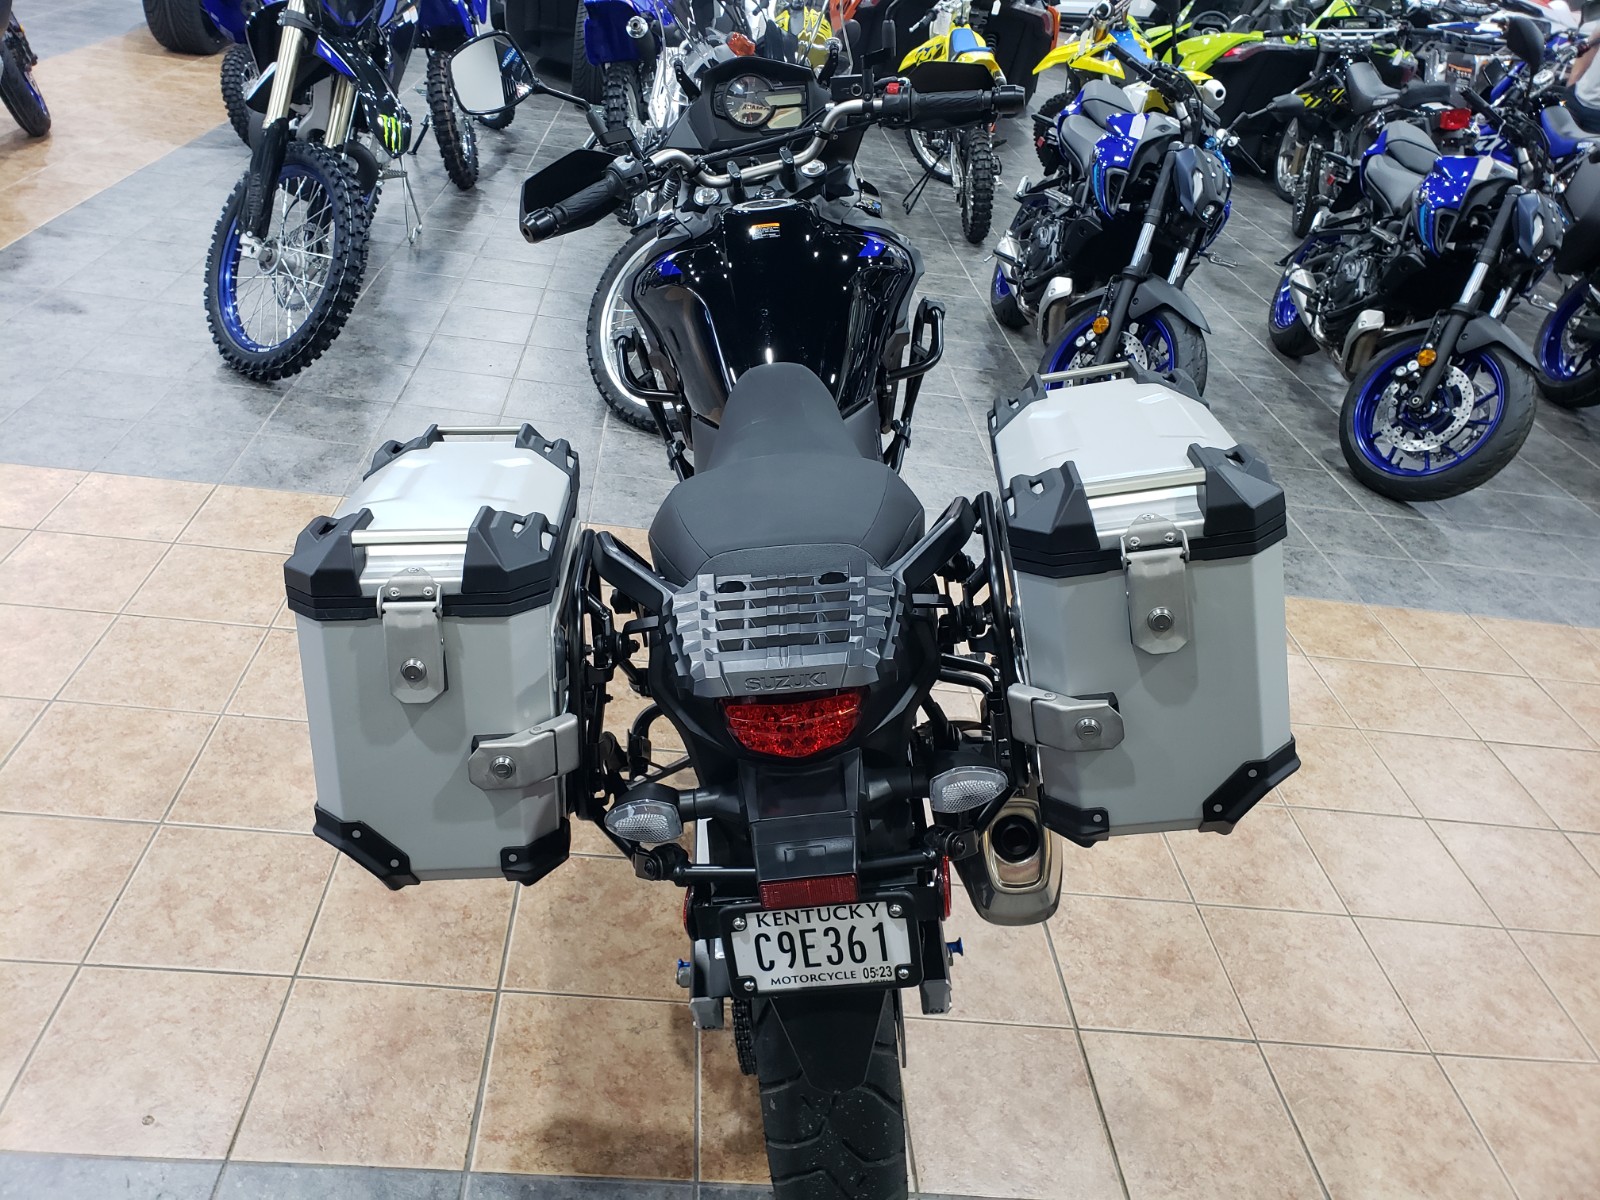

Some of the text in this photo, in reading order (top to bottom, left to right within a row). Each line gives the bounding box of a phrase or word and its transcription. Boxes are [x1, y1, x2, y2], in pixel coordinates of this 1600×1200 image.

[745, 672, 828, 691] SUZUKI
[756, 902, 880, 927] KENTUCKY
[754, 921, 888, 972] C9E361
[770, 970, 857, 986] MOTORCYCLE
